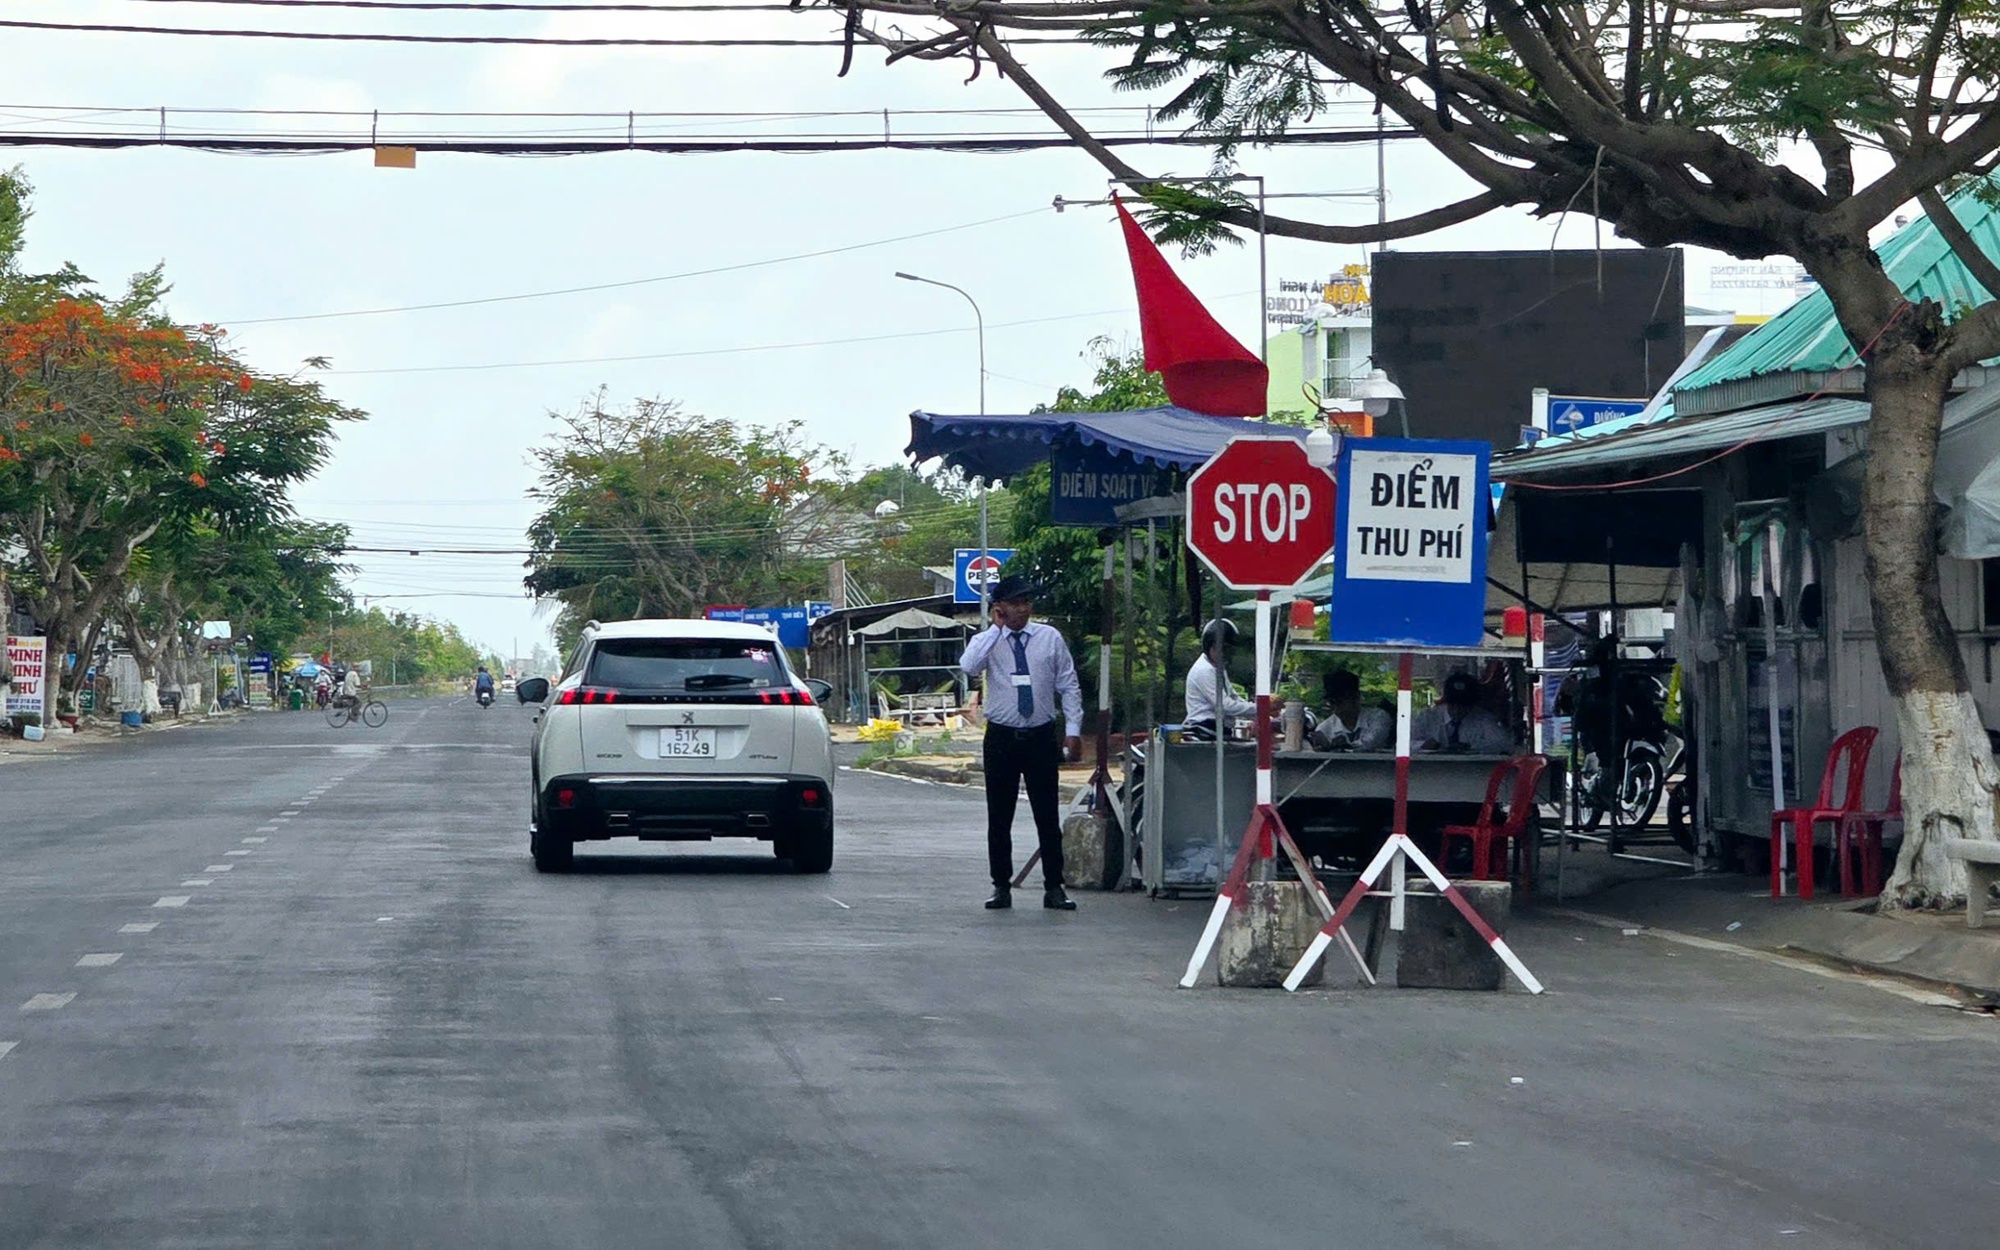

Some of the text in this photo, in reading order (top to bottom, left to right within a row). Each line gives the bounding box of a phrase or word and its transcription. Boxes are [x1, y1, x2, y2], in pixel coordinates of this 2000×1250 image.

[1060, 459, 1097, 498] ĐIỂM
[1101, 466, 1137, 499] SOÁT
[1371, 458, 1460, 510] ĐIỂM
[1213, 482, 1311, 543] STOP
[1357, 523, 1464, 559] THU PHÍ
[968, 571, 999, 580] PEPS
[667, 743, 710, 755] 162.49
[676, 730, 699, 742] 51K
